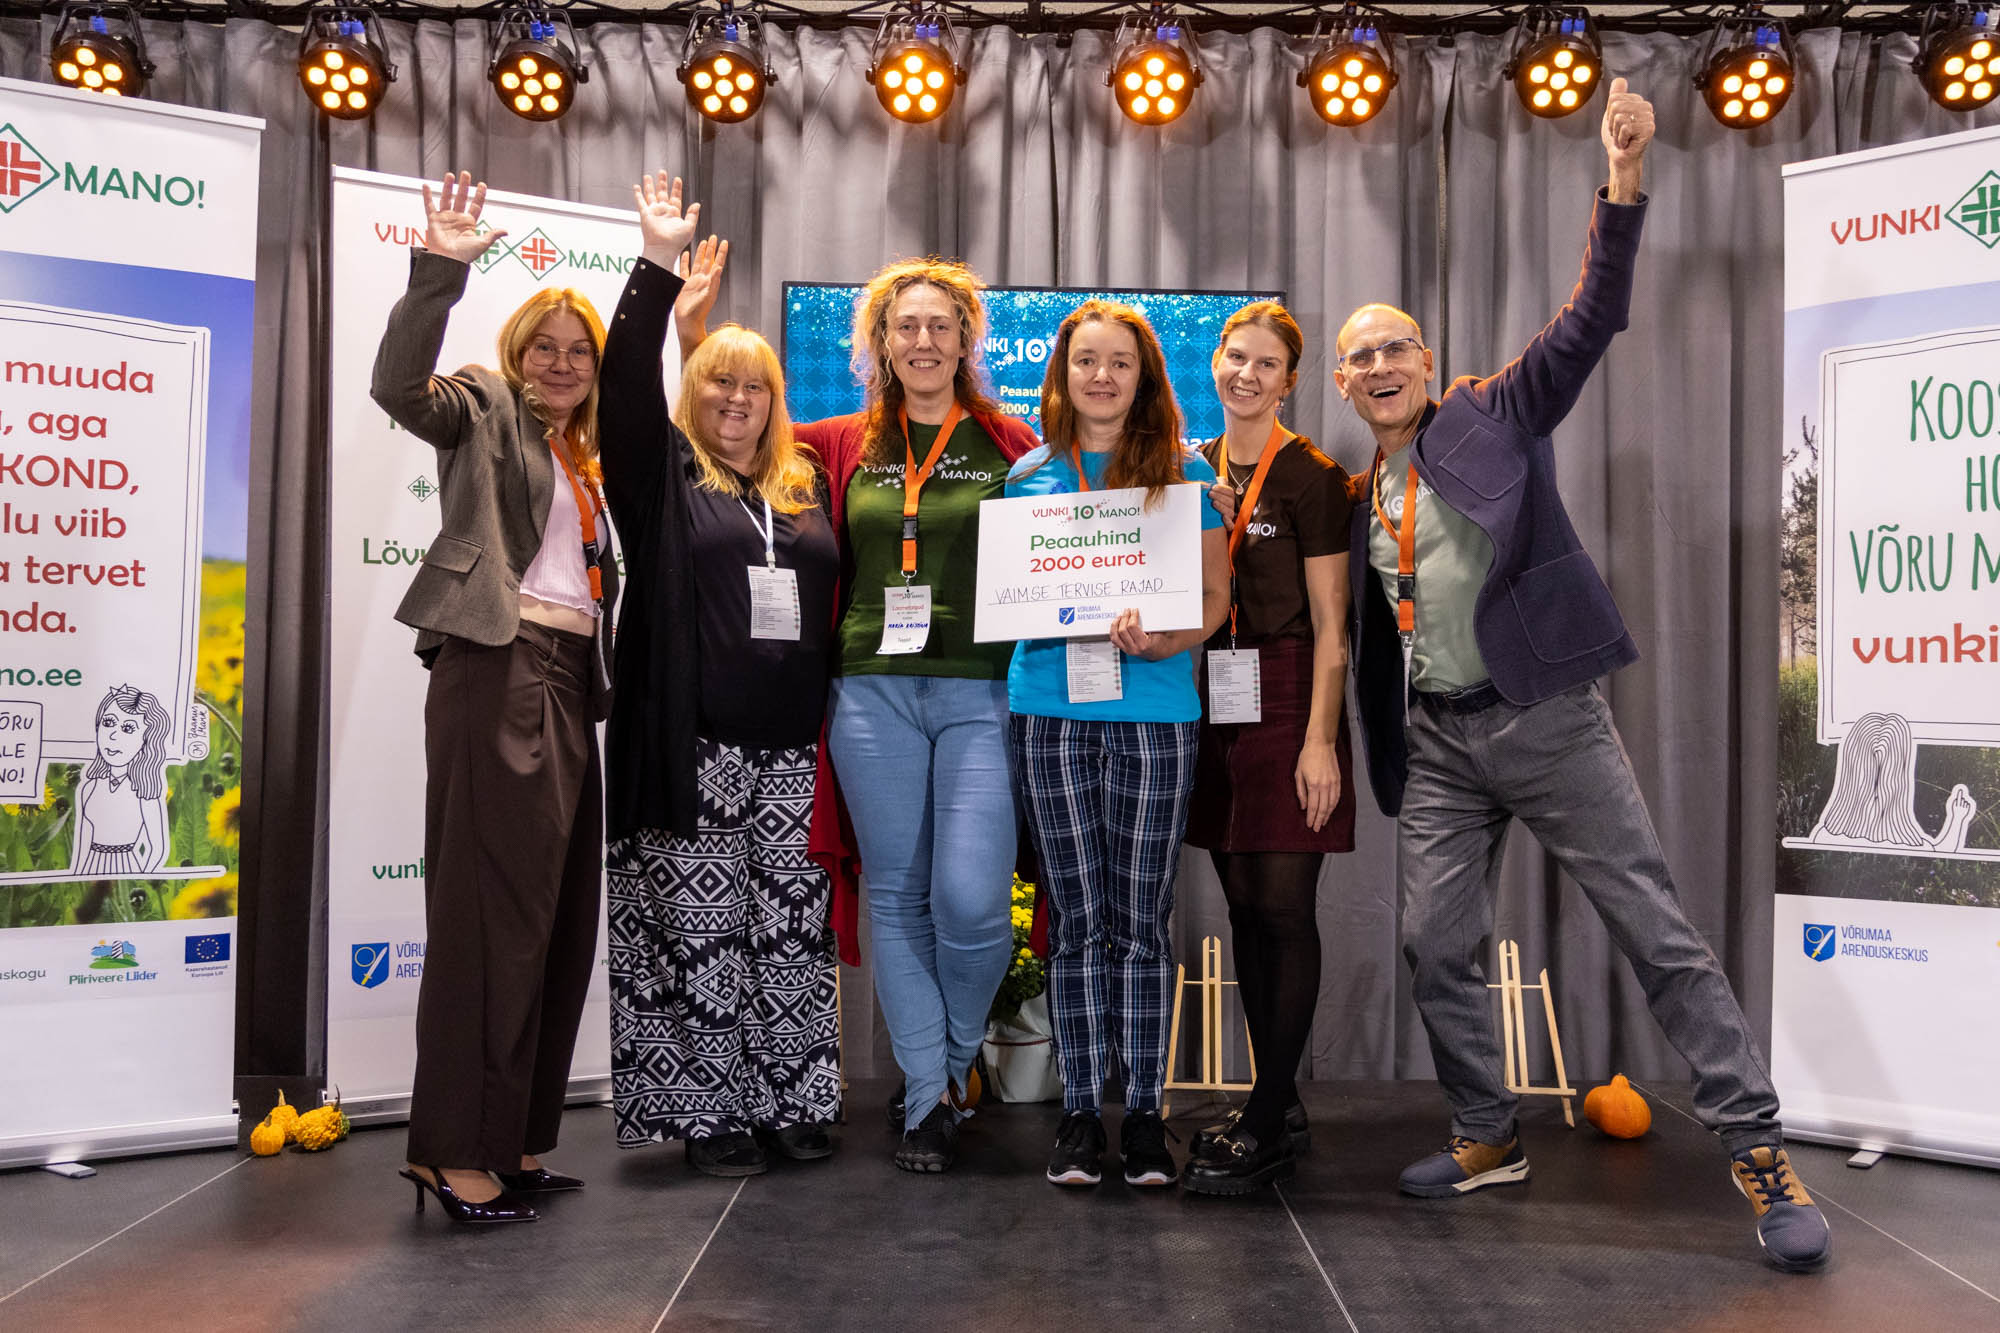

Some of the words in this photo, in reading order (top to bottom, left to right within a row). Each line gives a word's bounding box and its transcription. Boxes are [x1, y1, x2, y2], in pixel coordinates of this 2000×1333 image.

[65, 161, 204, 209] MANO!
[1831, 204, 1940, 245] VUNKI
[1014, 338, 1047, 363] 10
[5, 361, 154, 394] muuda
[999, 403, 1030, 415] 2000
[1910, 376, 2000, 442] KOO
[28, 411, 107, 441] aga
[941, 470, 992, 482] MANO!
[55, 507, 127, 539] viib
[1032, 506, 1069, 518] VUNKI
[1073, 505, 1094, 520] 10
[1099, 506, 1140, 518] MANO!
[1030, 527, 1141, 551] Peaauhind
[24, 555, 146, 587] tervet
[1030, 555, 1086, 573] 2000
[1092, 550, 1146, 568] eurot
[1850, 524, 1953, 594] VÕRU
[995, 585, 1051, 604] VAIMSE
[1057, 581, 1112, 599] TERVISE
[1120, 577, 1163, 595] RAJAD
[1852, 622, 1999, 664] vunki
[1841, 924, 1892, 942] VÕRUMAA
[1841, 943, 1929, 962] ARENDUSKESKUS
[0, 968, 46, 981] skogu
[69, 973, 123, 985] Piiriveere
[125, 970, 158, 982] Liider
